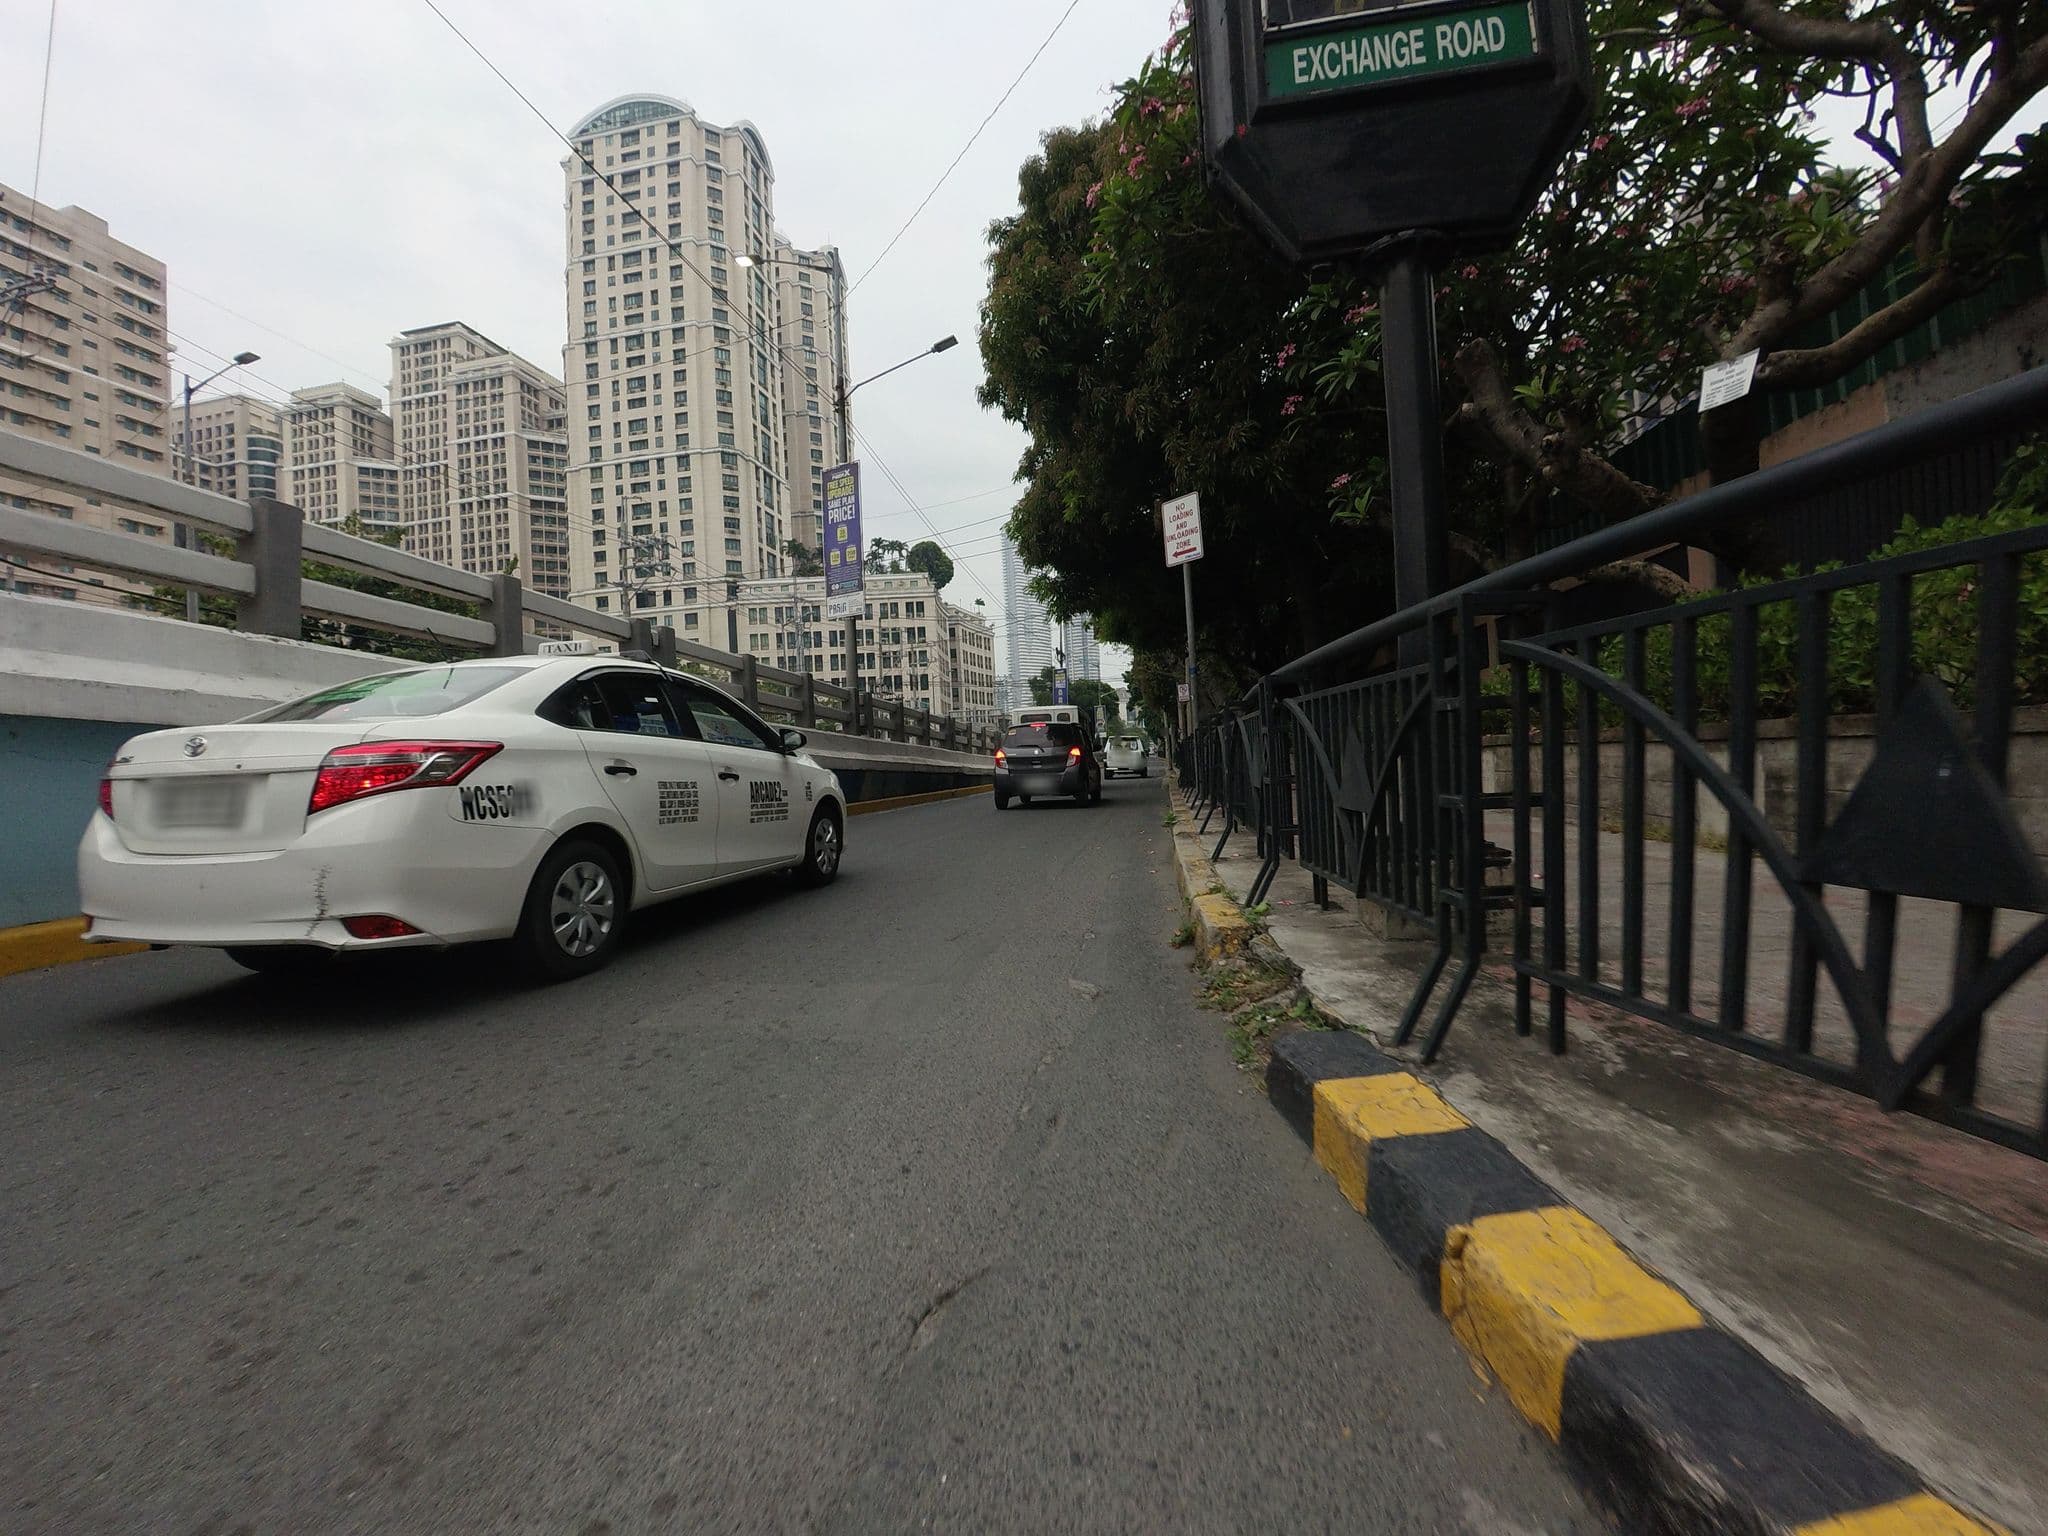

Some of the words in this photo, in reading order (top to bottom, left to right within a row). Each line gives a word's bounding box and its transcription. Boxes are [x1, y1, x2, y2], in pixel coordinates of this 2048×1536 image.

[1292, 28, 1427, 85] EXCHANGE
[1435, 15, 1506, 61] ROAD
[827, 497, 842, 510] SAME
[841, 494, 855, 506] PLAN
[1175, 502, 1186, 511] NO
[828, 503, 856, 525] PRICE!
[1168, 508, 1194, 523] LOADING
[1176, 521, 1188, 531] AND
[1166, 526, 1199, 543] UNLOADING
[1176, 538, 1192, 550] ZONE
[750, 780, 783, 803] ARCADE2
